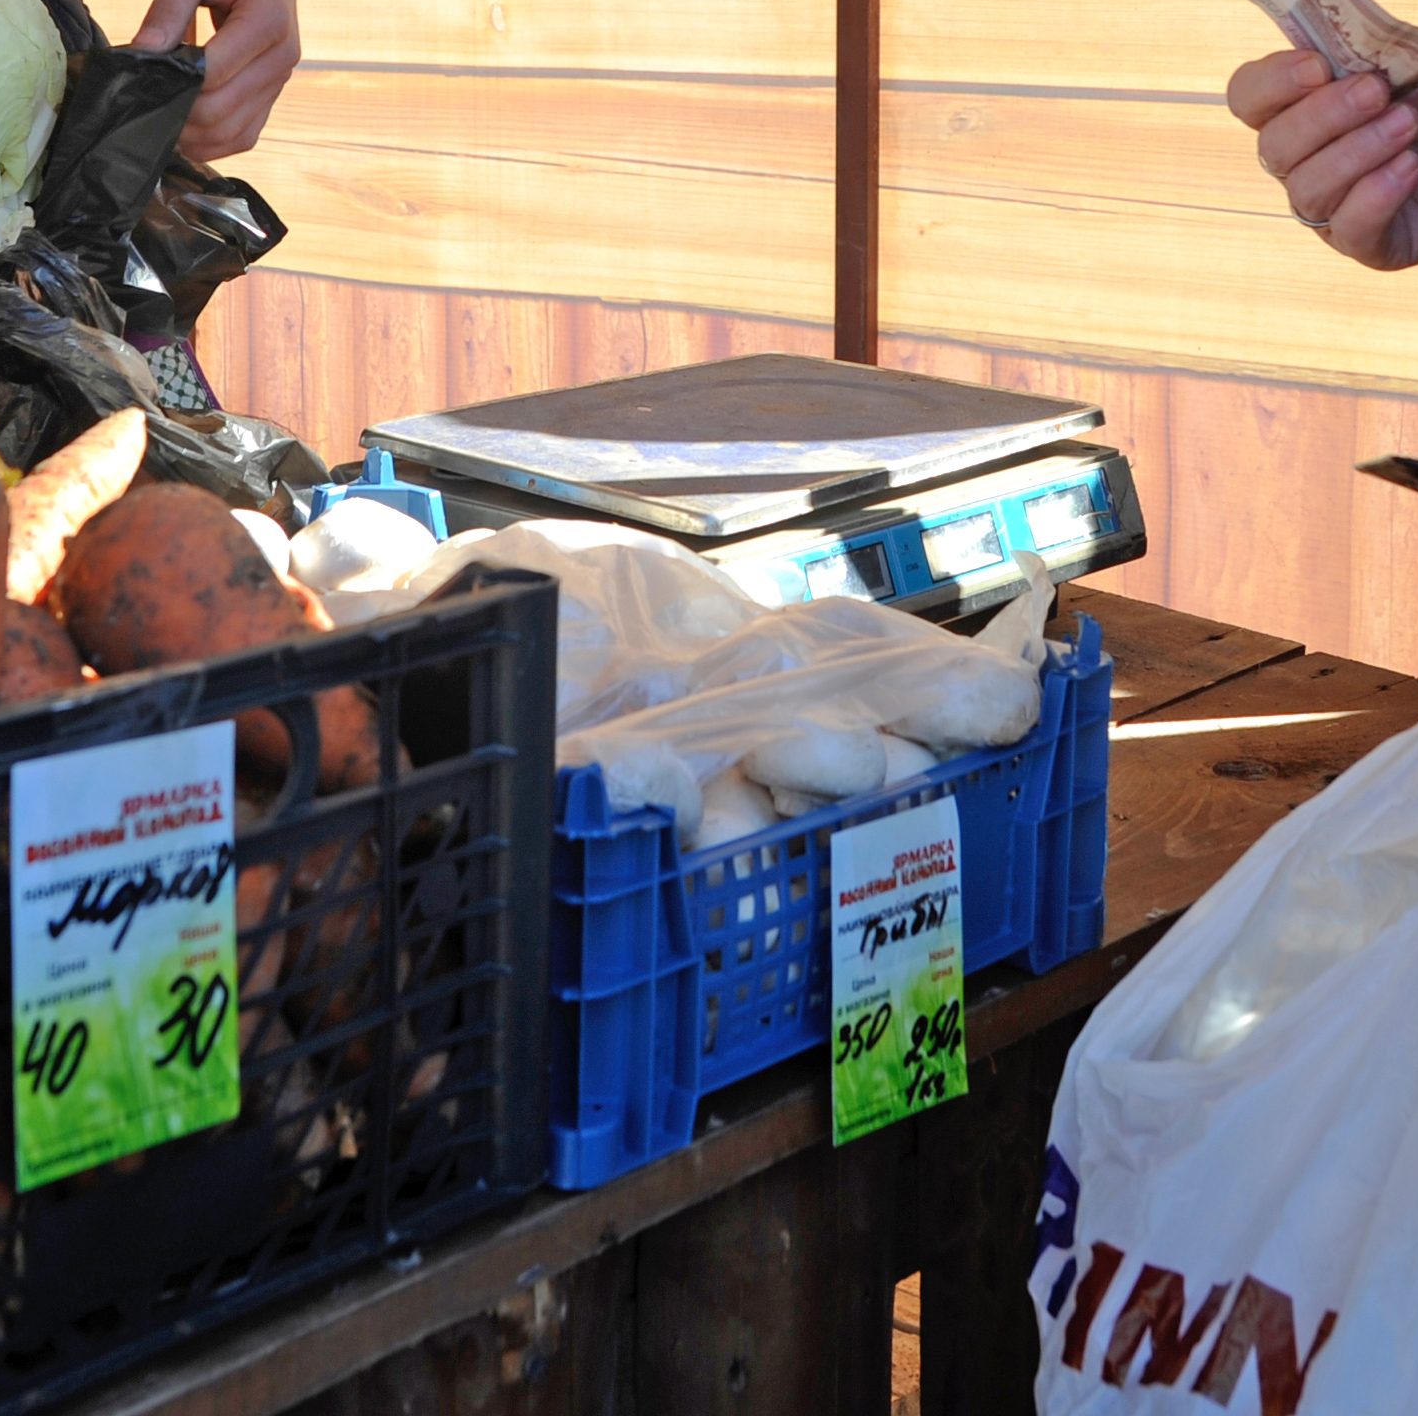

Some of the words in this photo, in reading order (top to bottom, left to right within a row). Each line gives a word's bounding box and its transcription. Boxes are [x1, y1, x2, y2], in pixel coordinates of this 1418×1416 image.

[121, 778, 222, 817] ЯРМАРКА
[894, 837, 955, 869] ЯРМАРКА
[859, 890, 948, 960] Грибы
[153, 973, 229, 1068] 30
[835, 1002, 892, 1065] 350
[21, 1019, 89, 1096] 40
